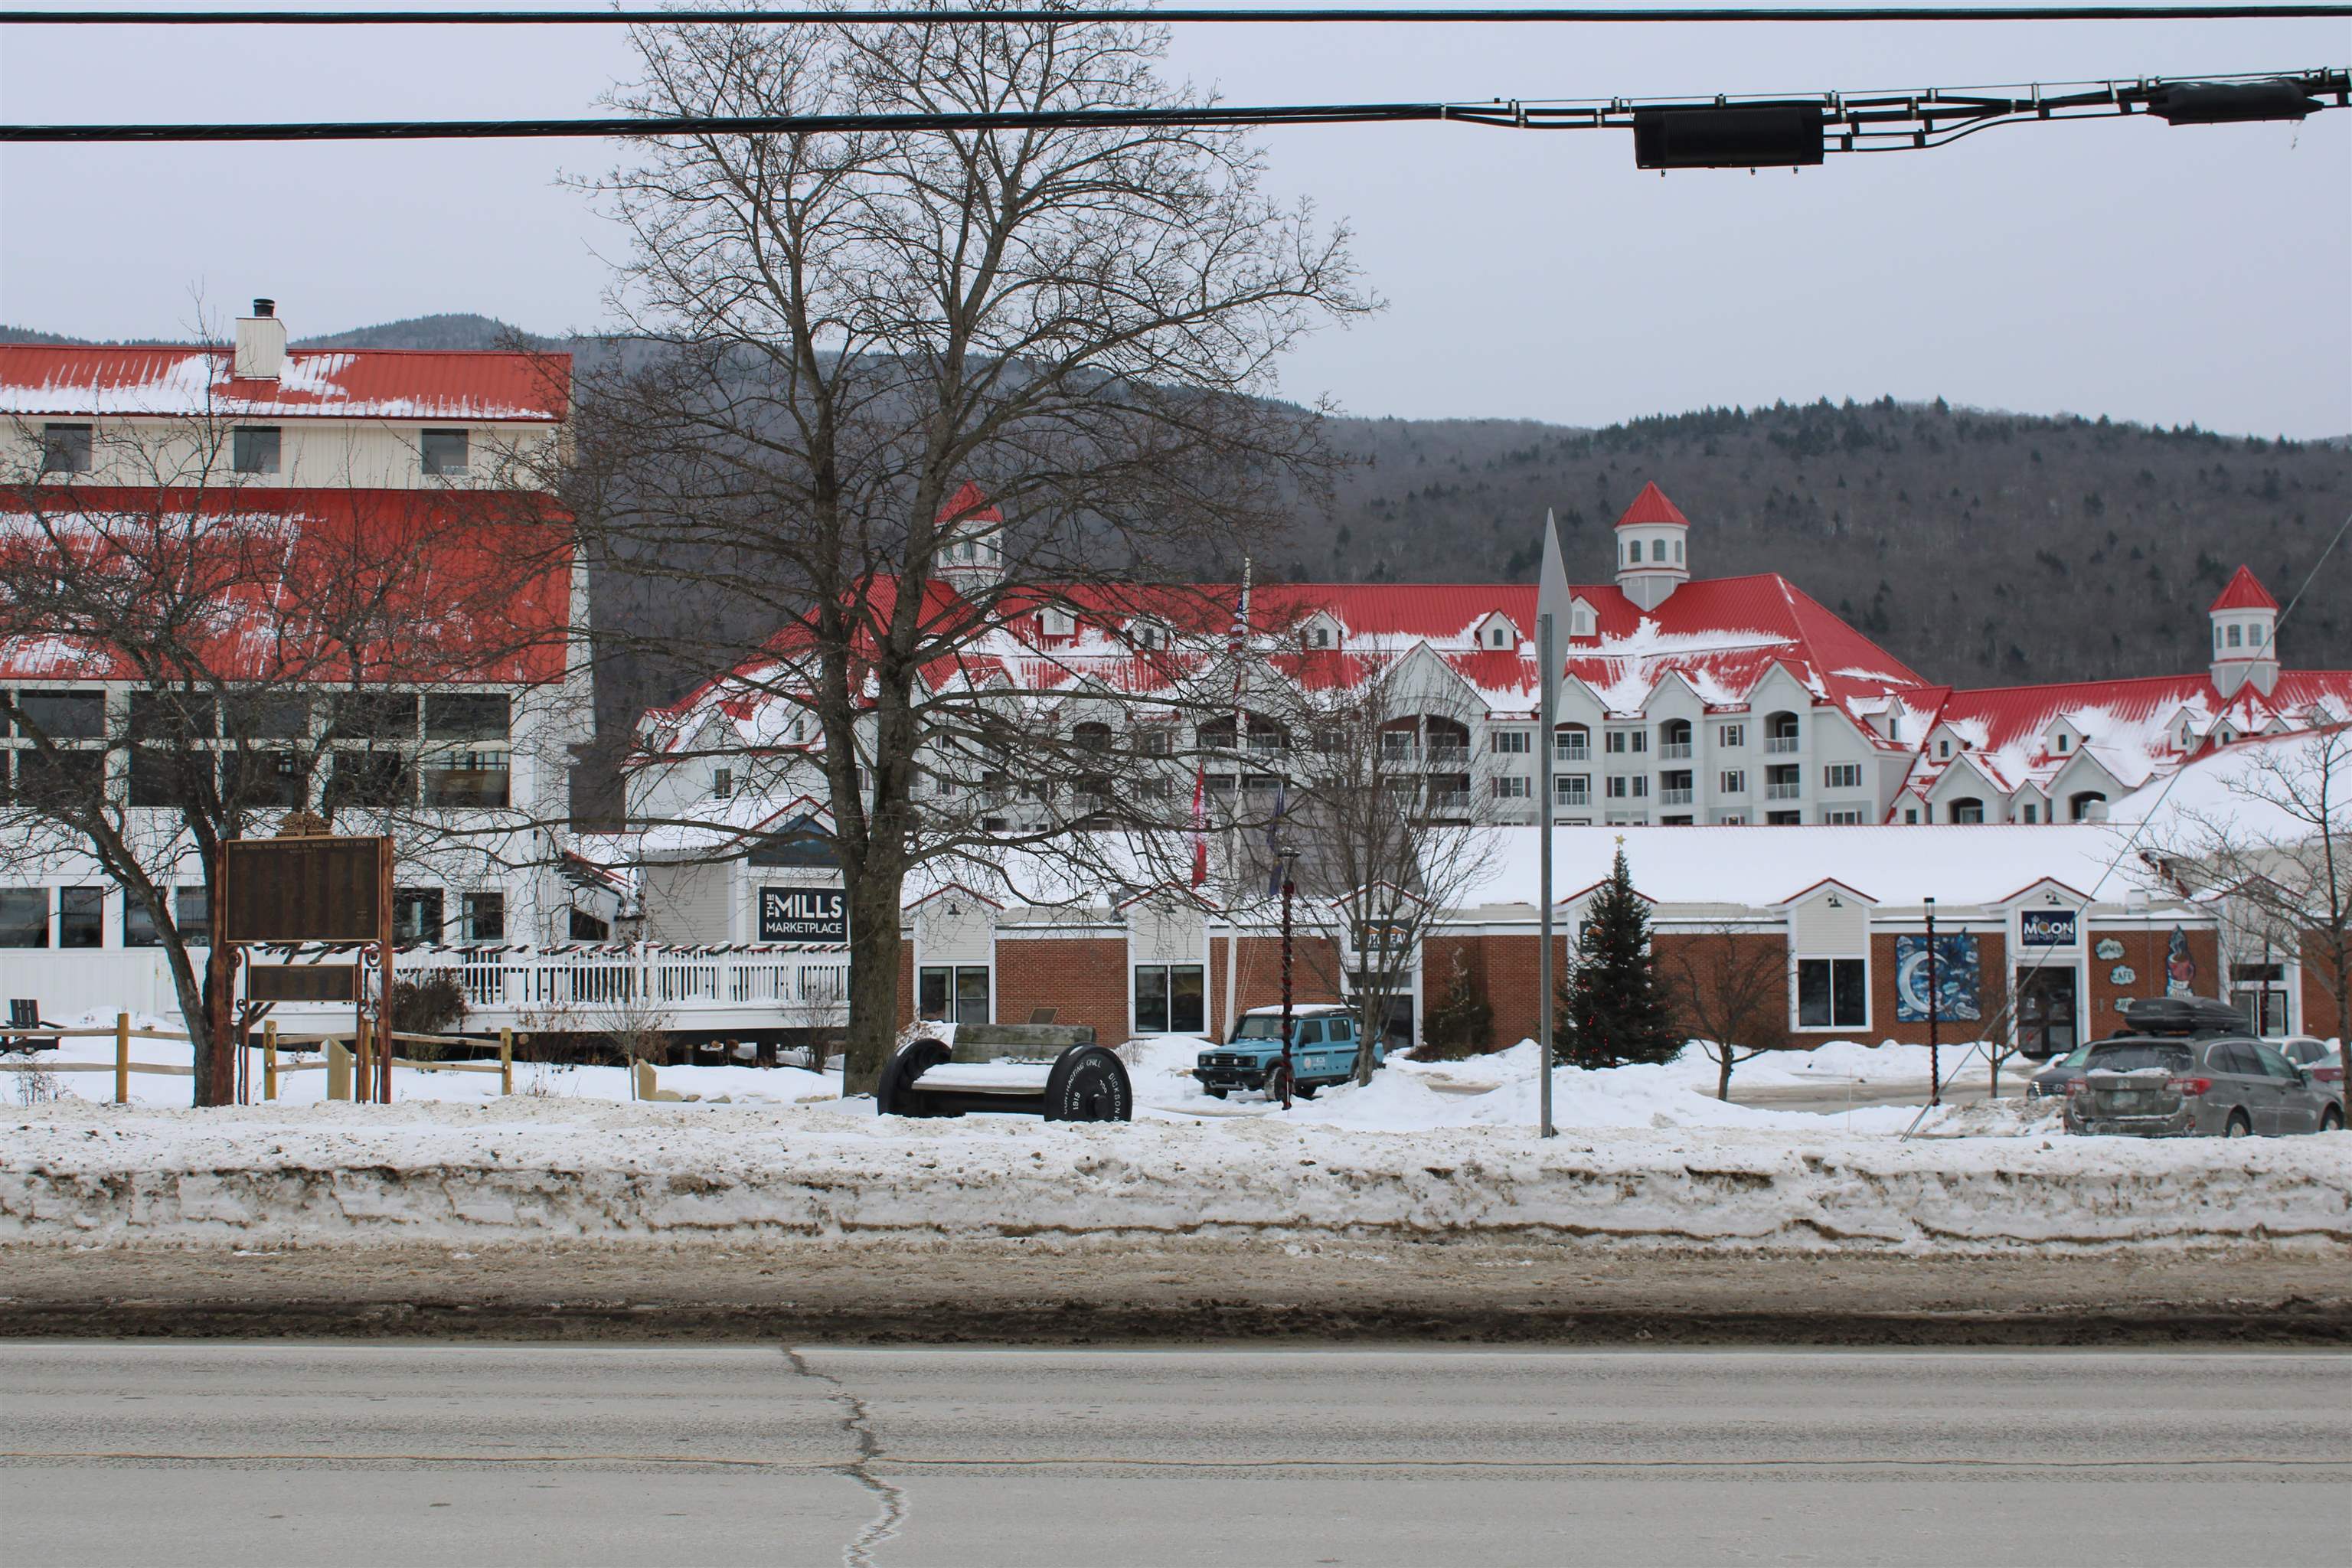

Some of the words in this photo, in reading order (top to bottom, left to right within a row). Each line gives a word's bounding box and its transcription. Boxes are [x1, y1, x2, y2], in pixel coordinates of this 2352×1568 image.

[766, 893, 775, 918] THE
[774, 893, 843, 919] MILLS
[766, 922, 842, 934] MARKETPLACE
[2024, 921, 2074, 935] MOON
[2112, 970, 2133, 981] CAFE
